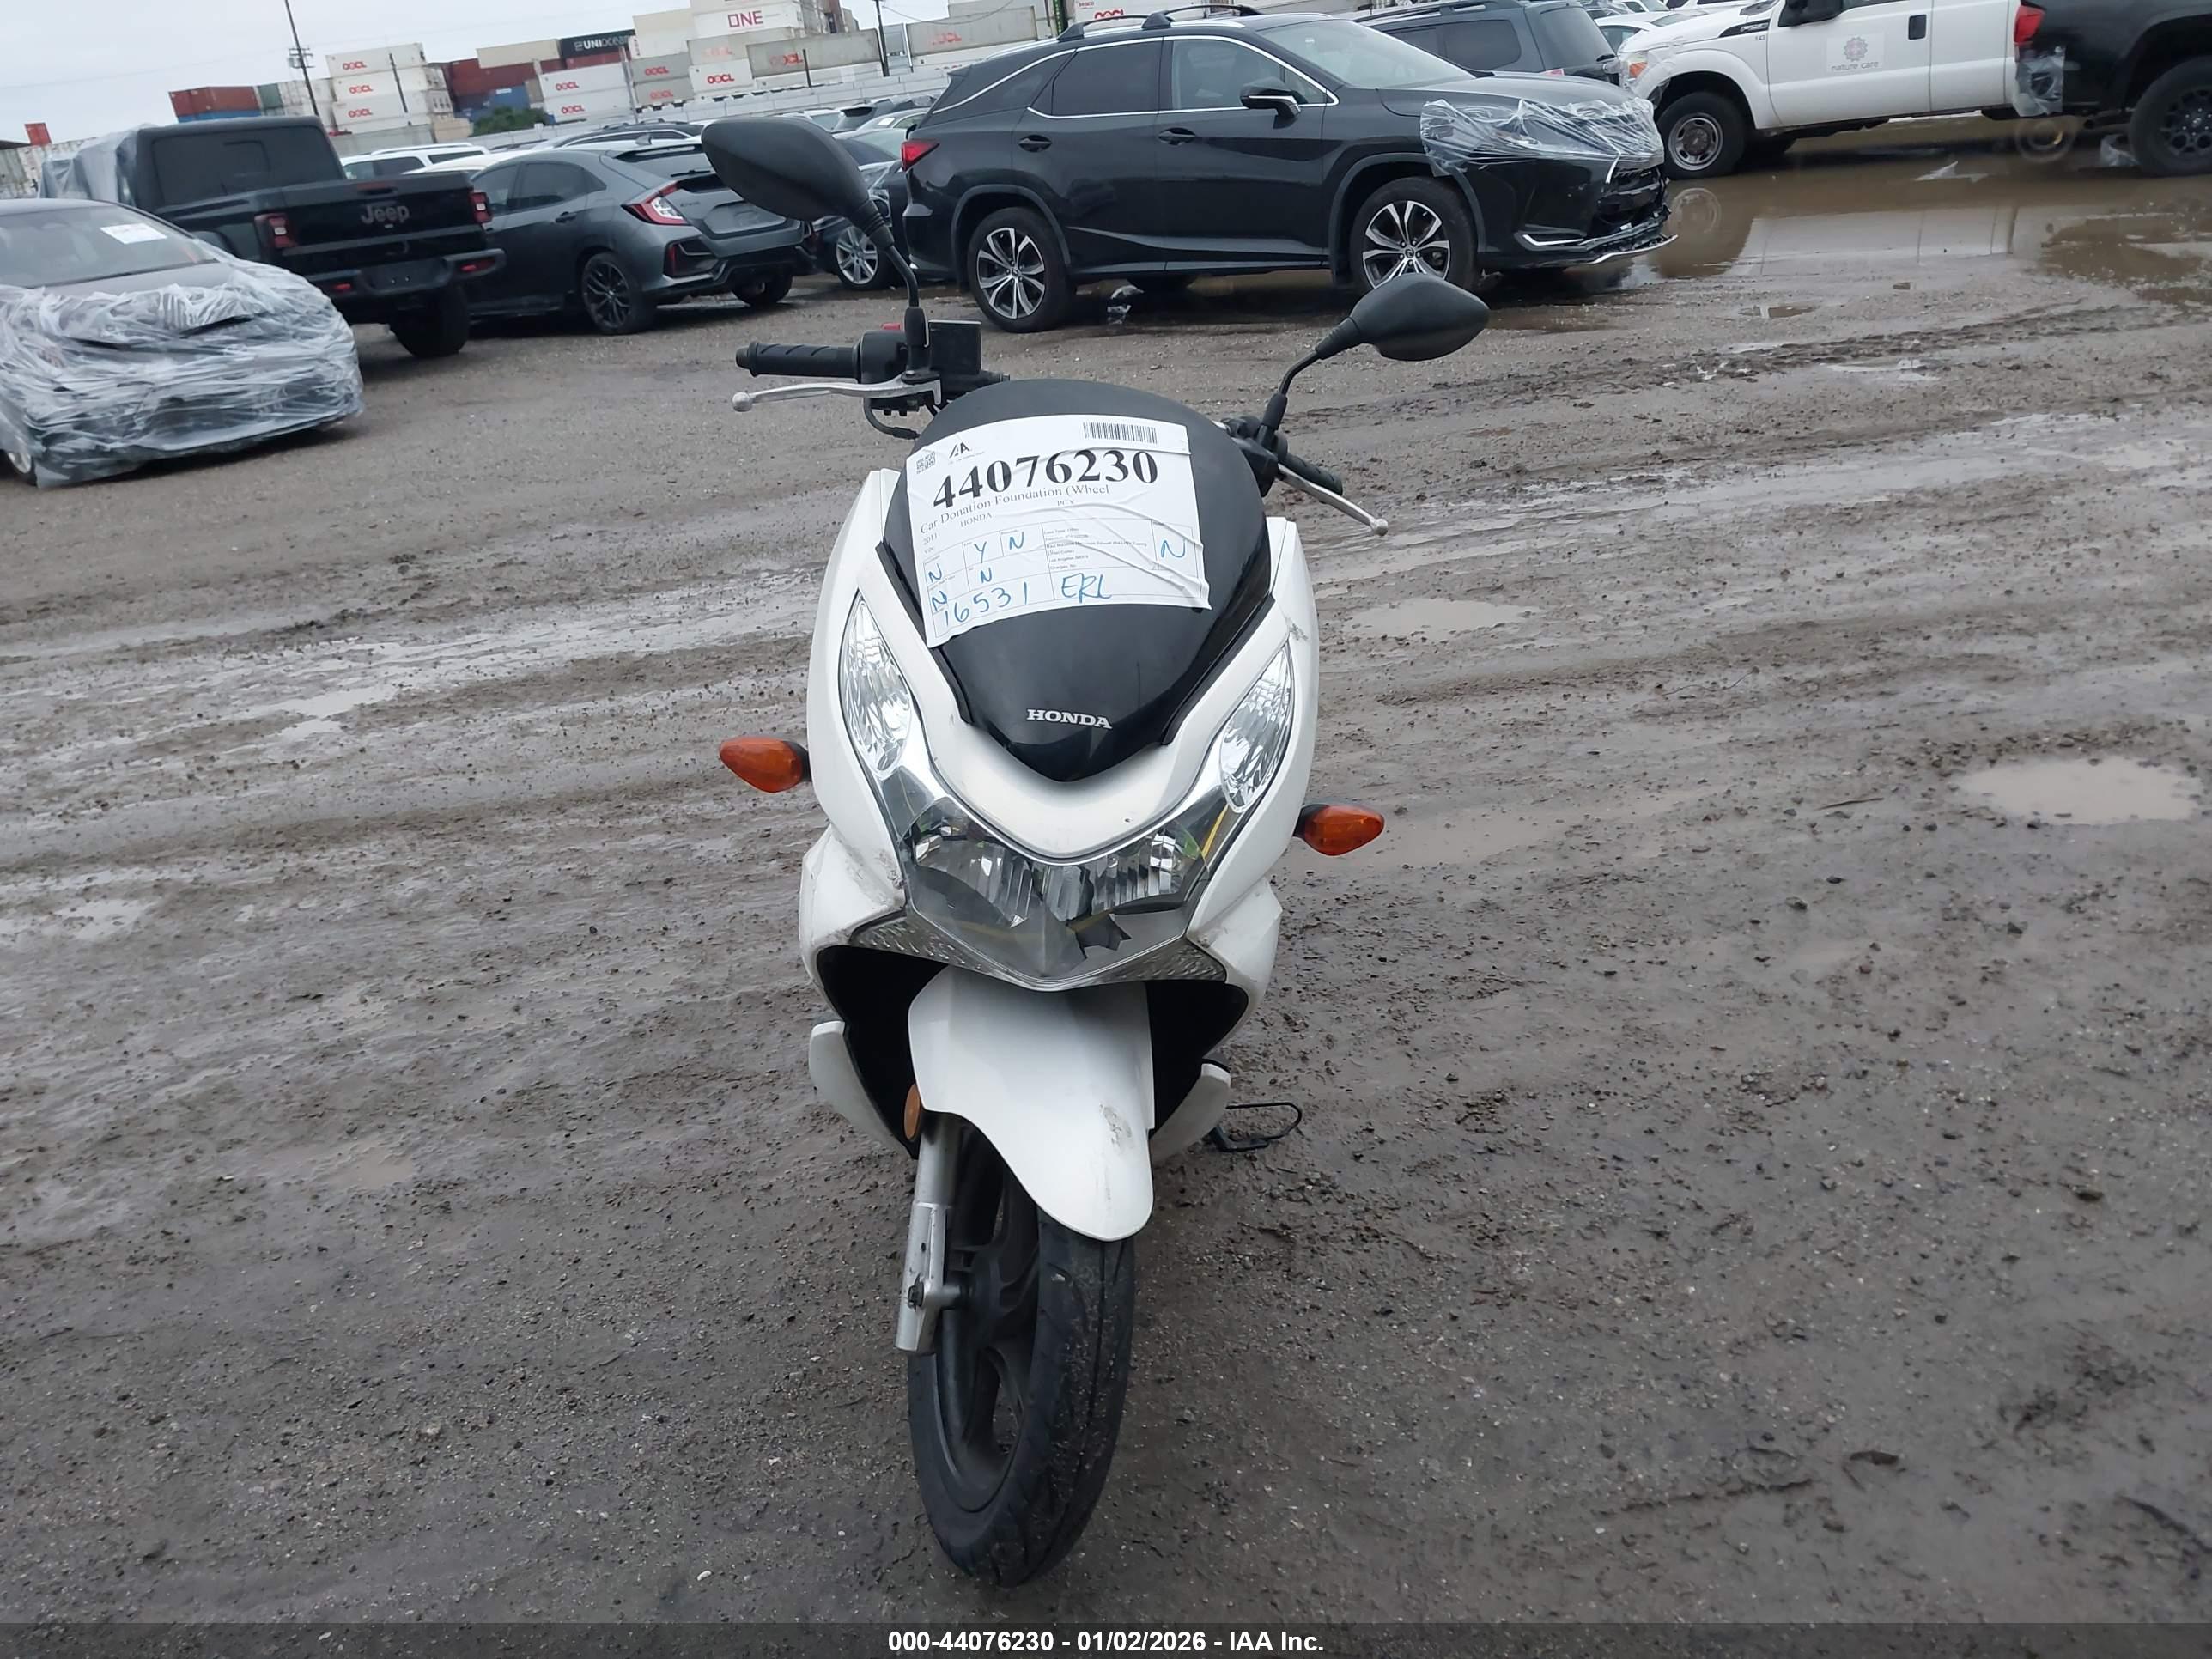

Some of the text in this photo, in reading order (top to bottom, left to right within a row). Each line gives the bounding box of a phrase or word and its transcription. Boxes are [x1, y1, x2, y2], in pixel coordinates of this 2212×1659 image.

[728, 10, 763, 27] ONE
[343, 61, 368, 70] OOCL
[645, 65, 669, 76] OOCL
[556, 82, 580, 90] OOCL
[708, 74, 734, 83] OOCL
[349, 84, 373, 94] OOCL
[650, 89, 673, 100] OOCL
[349, 108, 373, 118] OOCL
[561, 105, 585, 114] OOCL
[361, 205, 410, 223] Jeep
[933, 449, 1158, 508] 44076230
[921, 484, 1109, 534] Car Donation Foundation (Wheel
[960, 513, 992, 527] HONDA
[1009, 531, 1024, 550] N
[1161, 538, 1186, 558] N
[973, 541, 987, 563] Y
[928, 563, 942, 583] N
[980, 567, 993, 584] N
[931, 590, 948, 612] N
[945, 580, 1028, 627] 16531
[1026, 709, 1112, 729] HONDA
